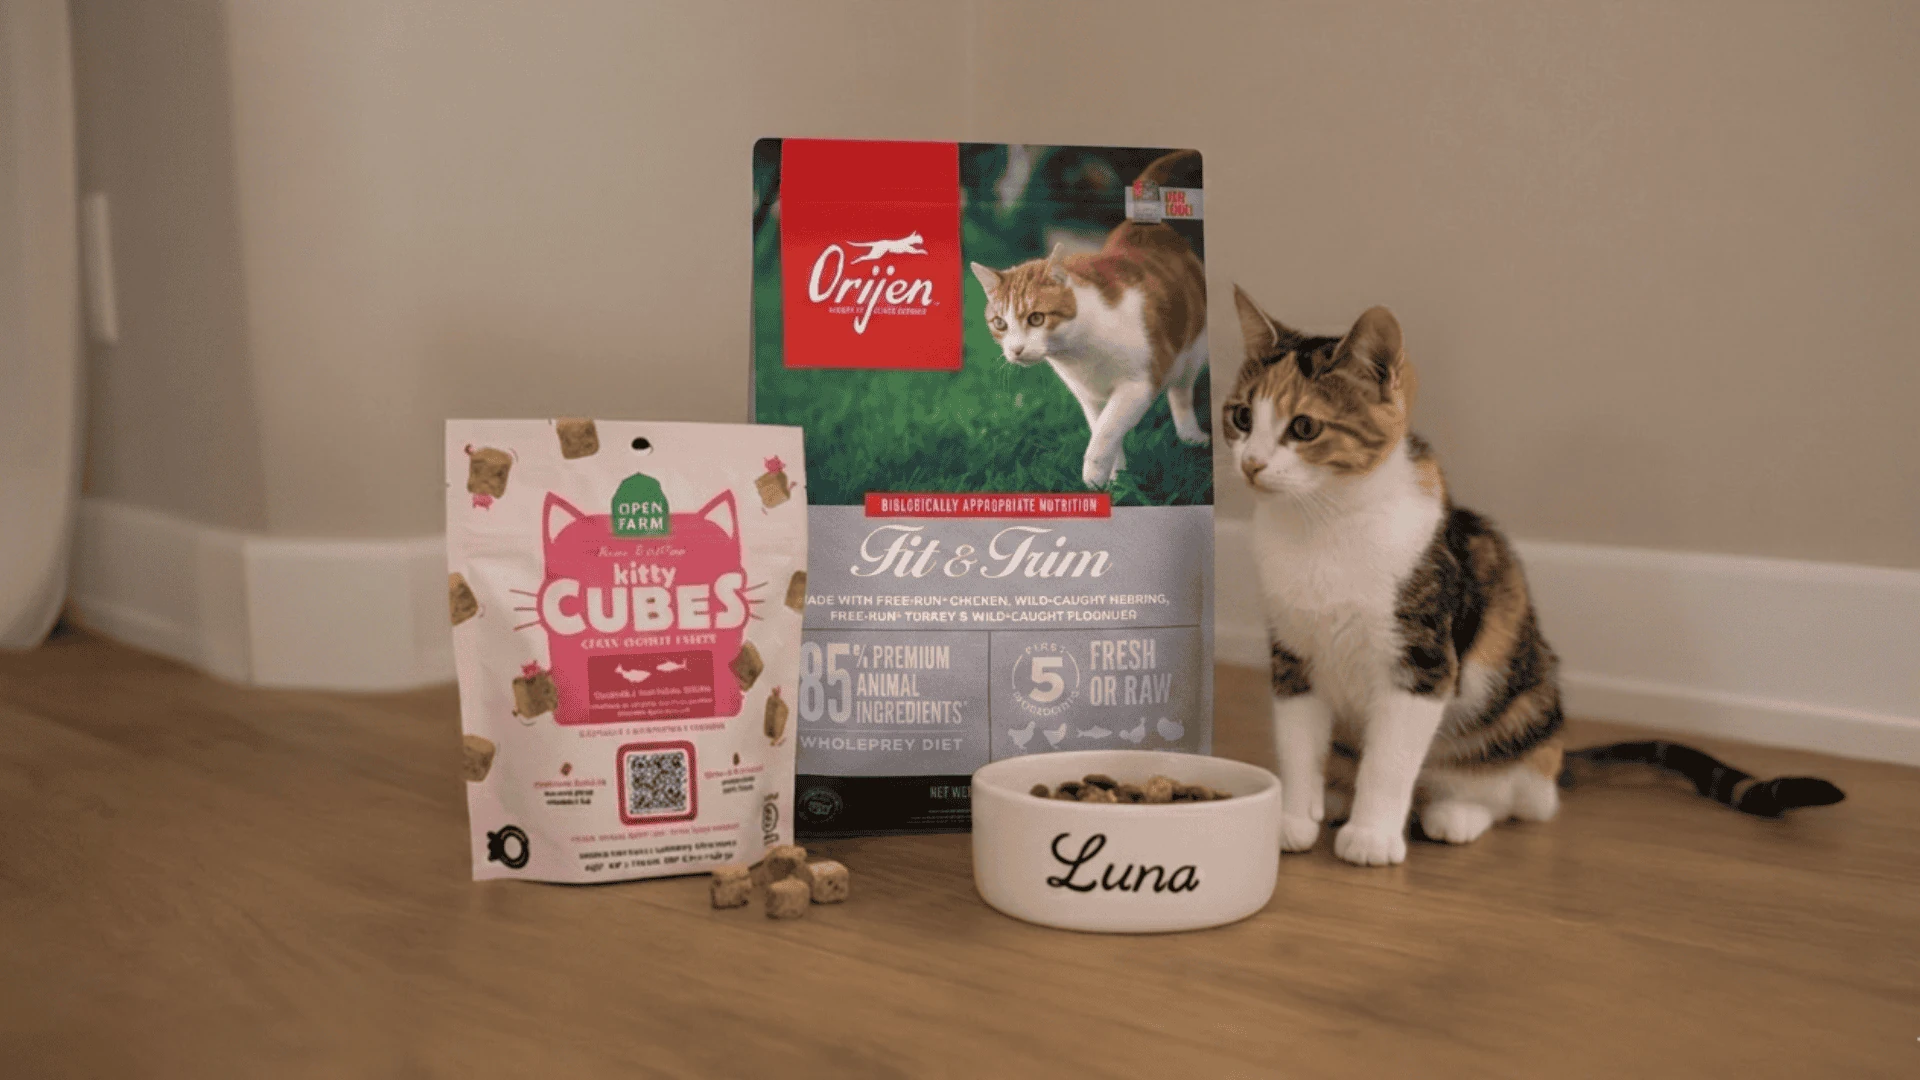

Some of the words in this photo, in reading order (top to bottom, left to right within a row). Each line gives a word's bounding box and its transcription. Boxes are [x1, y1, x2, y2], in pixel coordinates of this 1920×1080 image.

[809, 243, 933, 335] Orijen
[618, 501, 663, 515] OPEN
[618, 517, 663, 530] FARM
[850, 524, 940, 578] Fit
[943, 544, 978, 578] &
[980, 525, 1113, 579] Trim
[613, 560, 676, 588] kitty
[541, 571, 747, 636] CUBES
[804, 594, 833, 606] ADE
[838, 595, 873, 606] WITH
[972, 611, 1063, 622] WILD-CAUGHT
[872, 645, 951, 670] PREMIUM
[1090, 638, 1157, 671] FRESH
[856, 672, 921, 698] ANIMAL
[1029, 656, 1065, 703] 5
[1090, 675, 1117, 706] OR
[1123, 672, 1173, 705] RAW
[801, 736, 915, 751] WHOLEPREY
[922, 738, 964, 751] DIET
[1046, 832, 1201, 893] Luna
